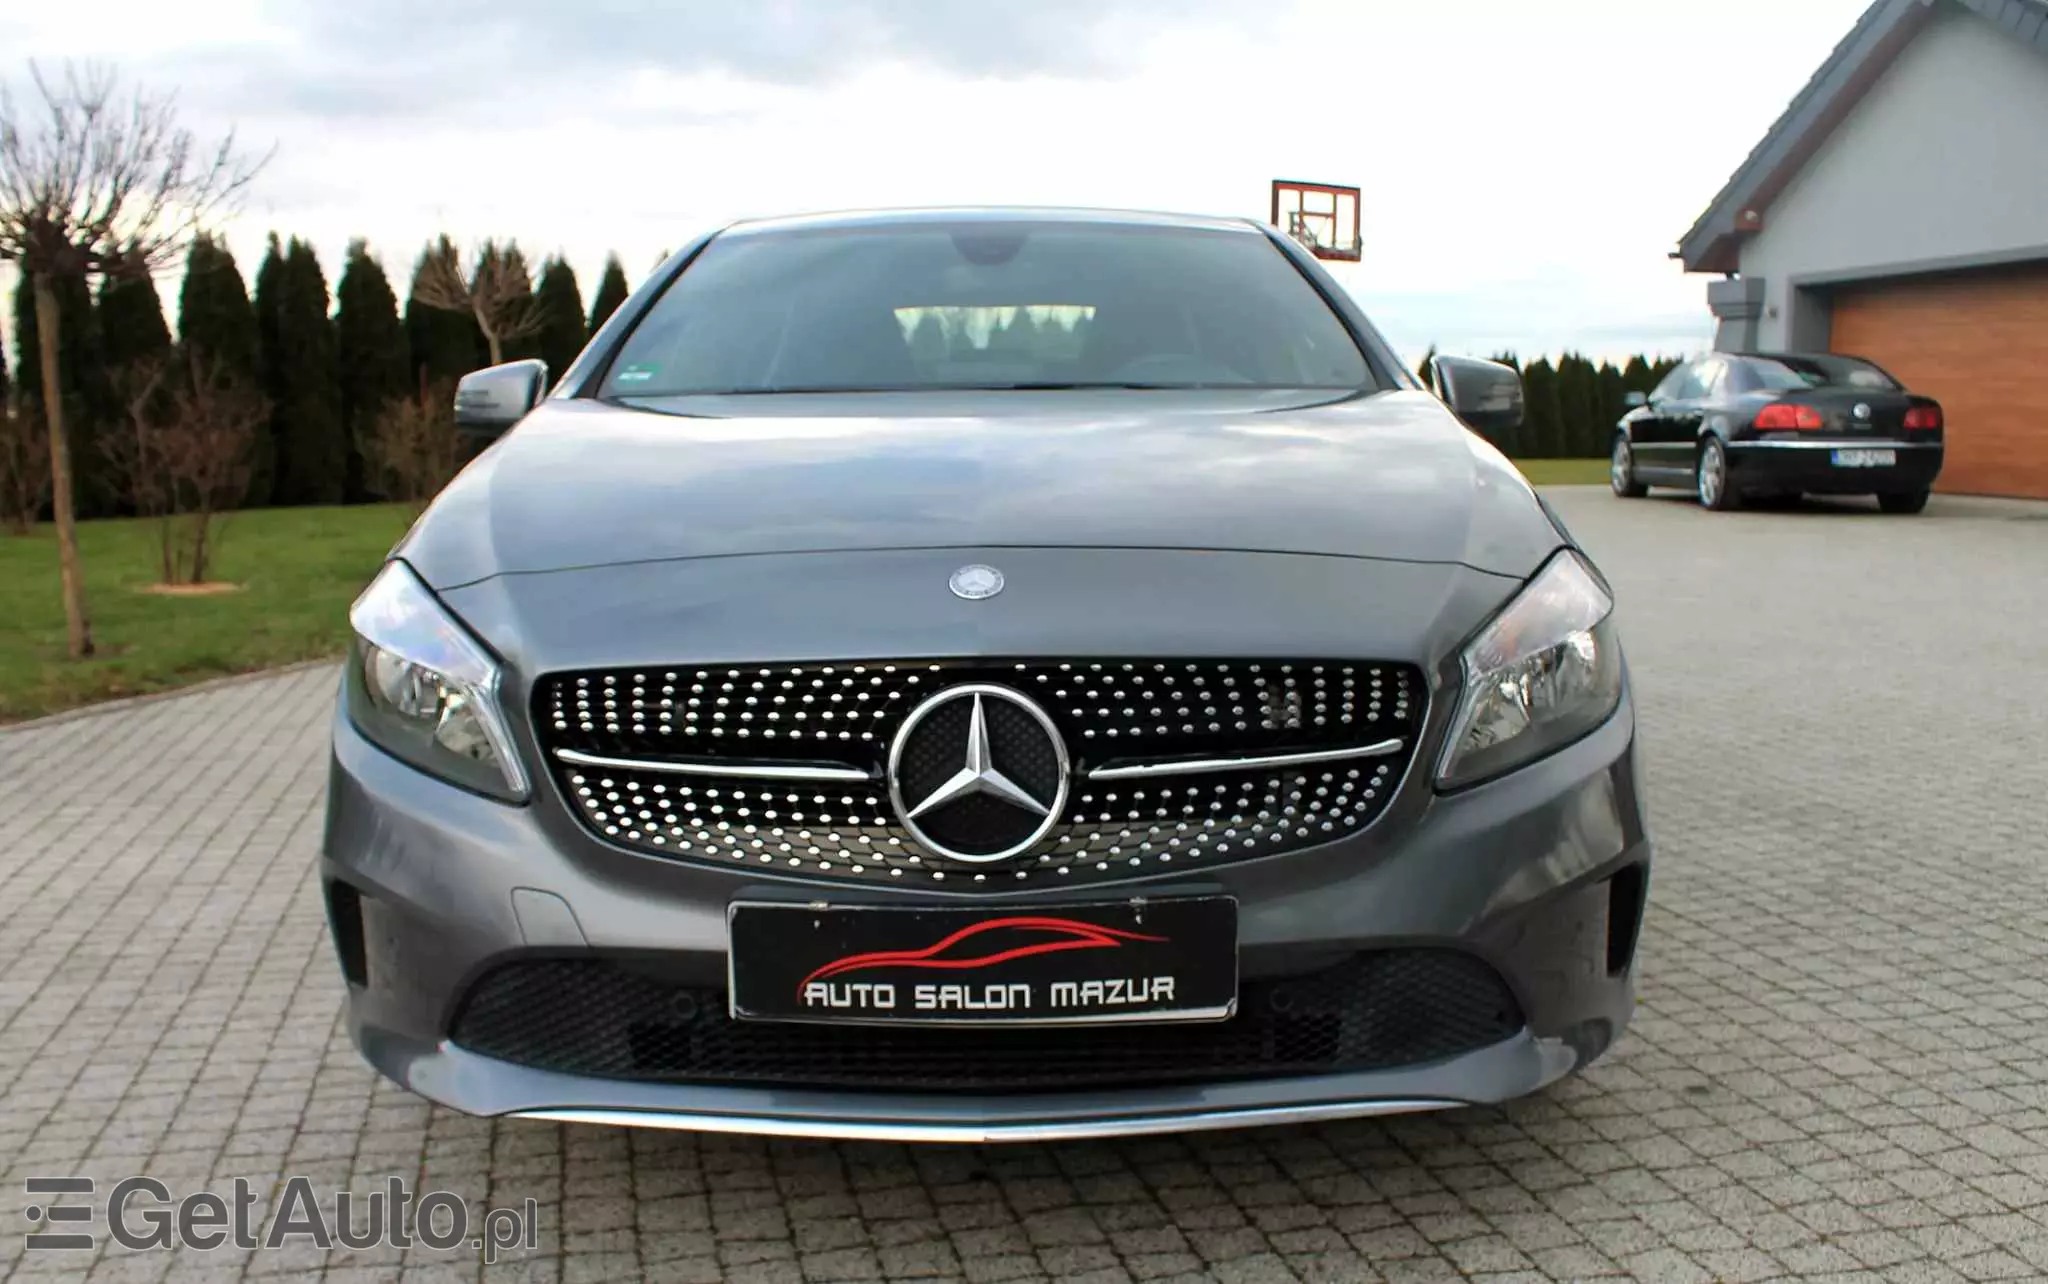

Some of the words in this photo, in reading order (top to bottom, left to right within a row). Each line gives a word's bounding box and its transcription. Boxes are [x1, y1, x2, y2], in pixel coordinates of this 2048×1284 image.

[804, 983, 895, 1008] AUTO
[915, 984, 1030, 1009] SALON
[1051, 976, 1175, 1007] MAZUR
